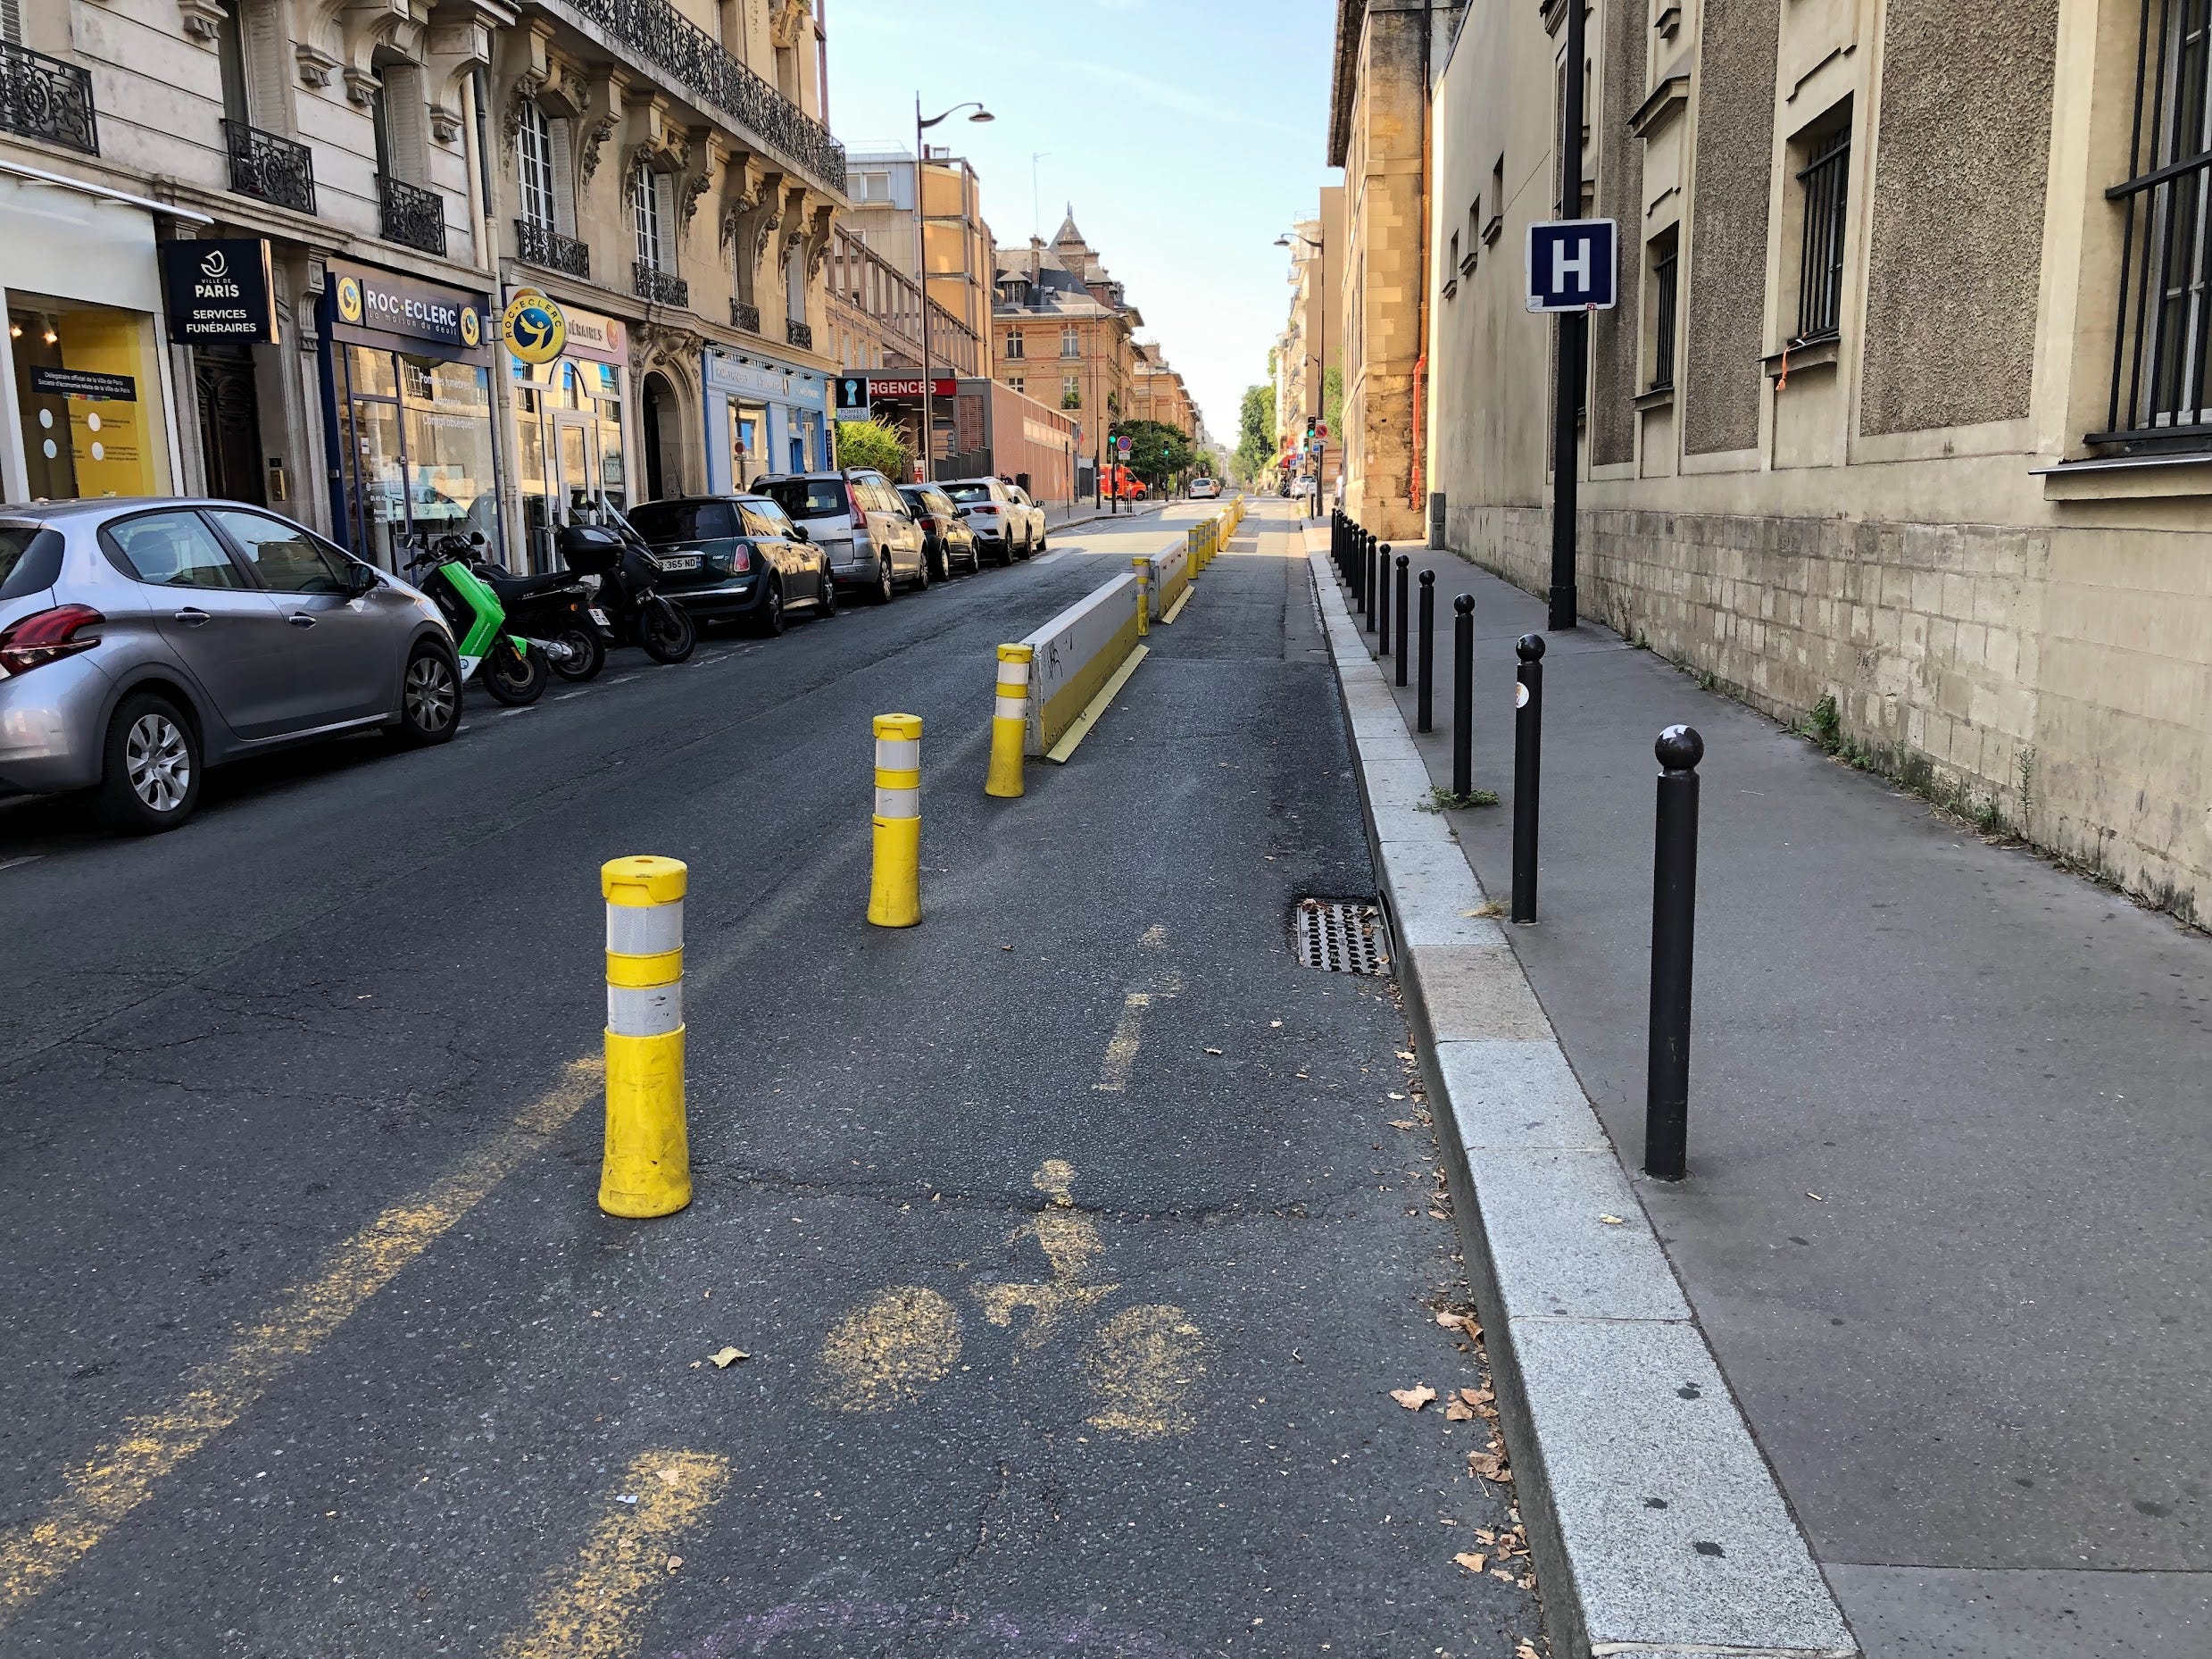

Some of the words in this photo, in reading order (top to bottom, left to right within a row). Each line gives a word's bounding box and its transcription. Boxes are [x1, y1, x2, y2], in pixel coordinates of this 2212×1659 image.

[1551, 238, 1591, 294] H
[195, 284, 240, 298] PARIS
[193, 309, 247, 320] SERVICES
[186, 321, 257, 333] FUNÉRAIRES
[385, 314, 417, 328] maison
[420, 321, 431, 330] du
[869, 380, 937, 395] RGENCES
